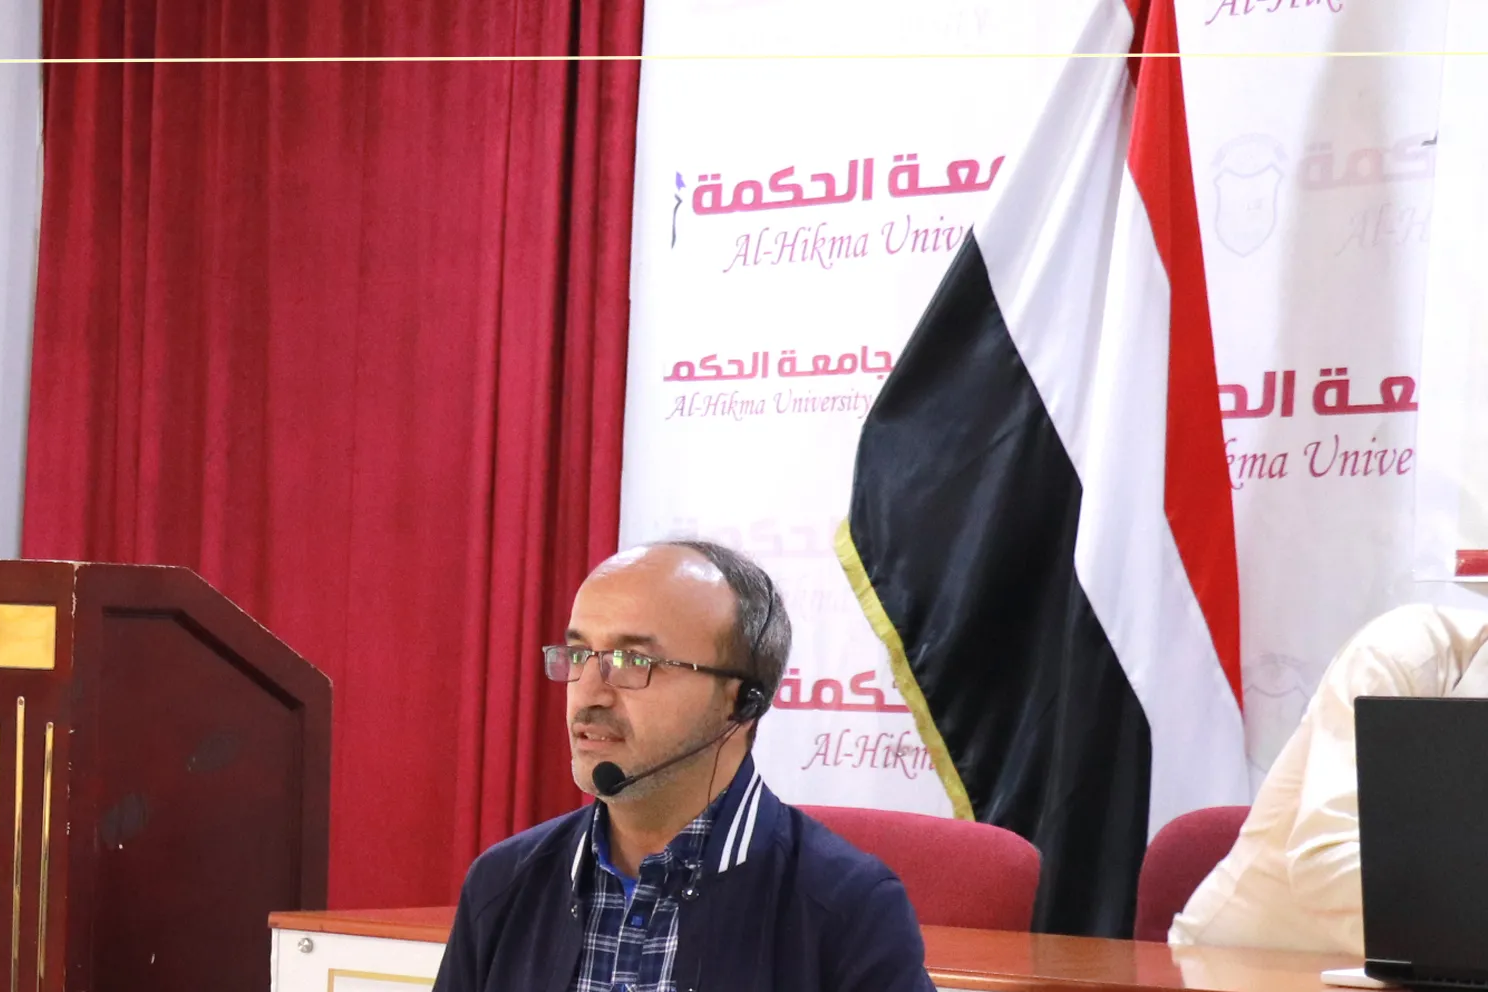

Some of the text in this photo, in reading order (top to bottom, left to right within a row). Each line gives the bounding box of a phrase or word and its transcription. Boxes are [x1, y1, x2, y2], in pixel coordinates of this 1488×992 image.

[692, 157, 875, 216] الحكمة
[722, 215, 966, 273] Al-Hikma Univ
[662, 344, 896, 383] جامعة الحكم
[664, 387, 872, 421] Al-Hikma University
[1303, 433, 1414, 479] Unive
[801, 728, 937, 780] Al-Hikm
